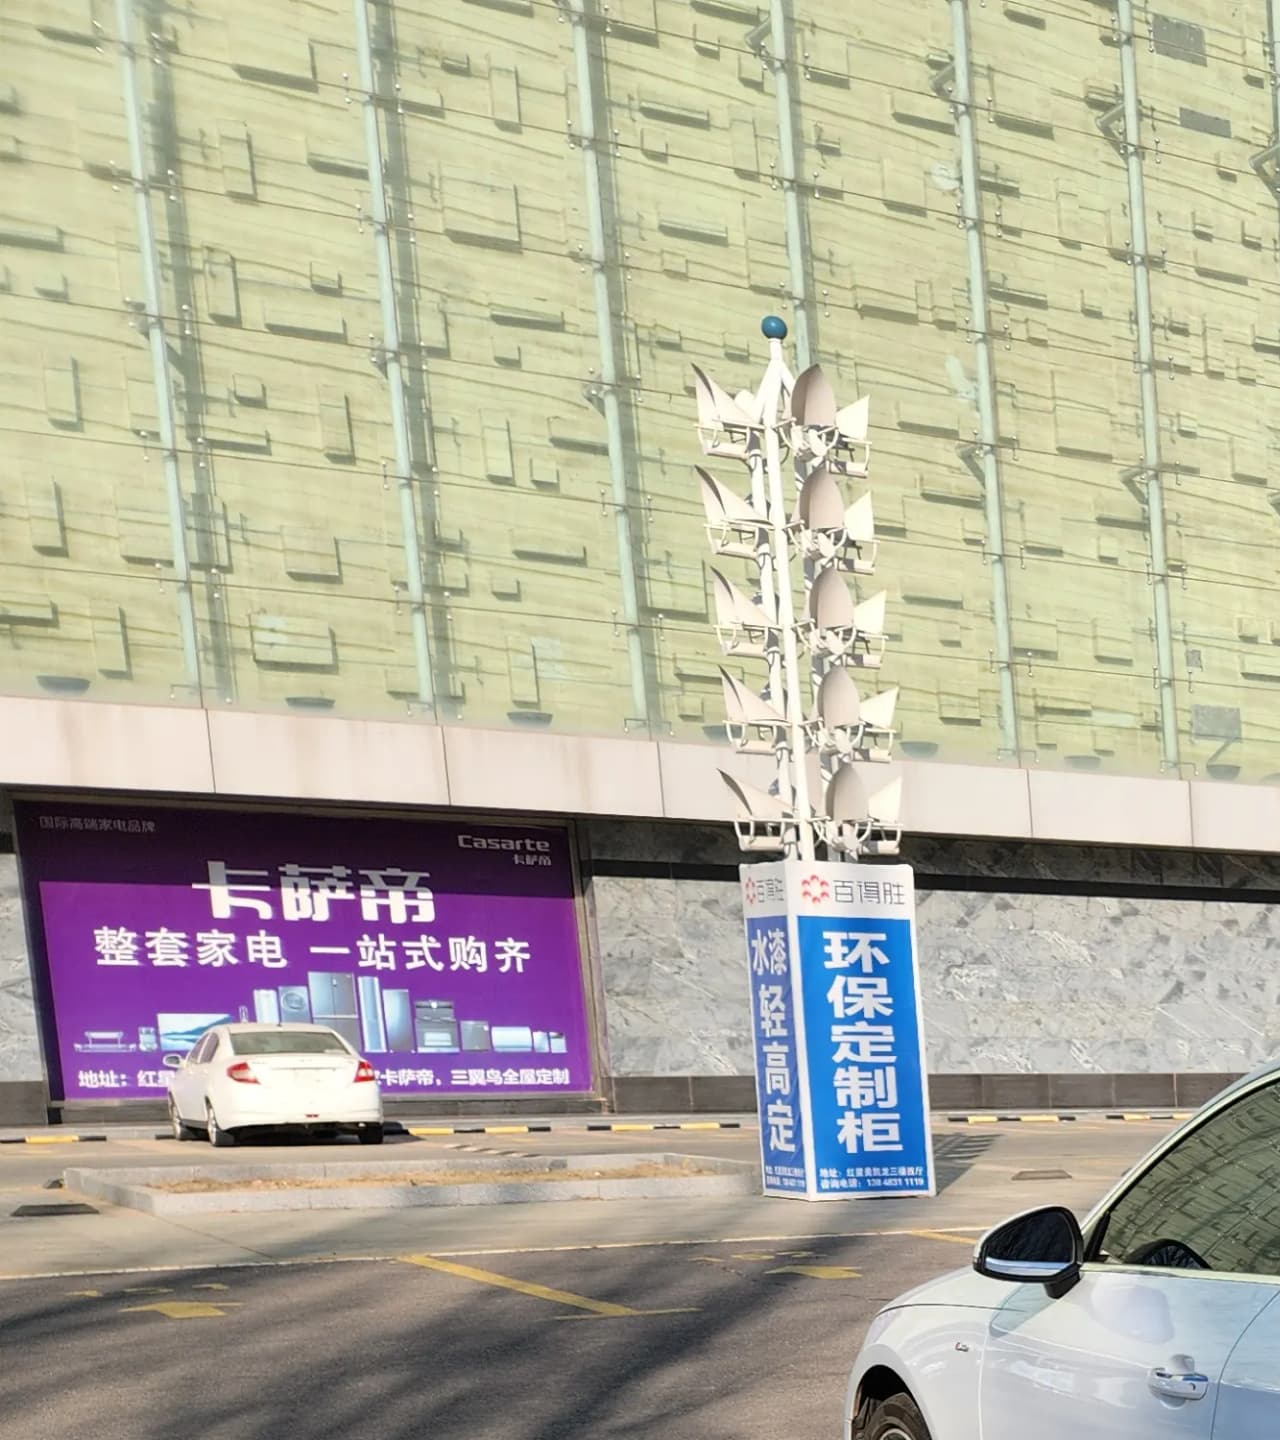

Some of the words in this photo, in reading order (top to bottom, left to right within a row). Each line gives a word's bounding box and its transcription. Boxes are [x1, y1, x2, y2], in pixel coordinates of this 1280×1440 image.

[457, 835, 551, 852] Casarte
[192, 860, 436, 924] 卡萨帝
[833, 879, 905, 905] 百得胜
[93, 926, 289, 969] 整套家电
[310, 932, 532, 974] 一站式购齐
[822, 930, 904, 1154] 环保定制柜
